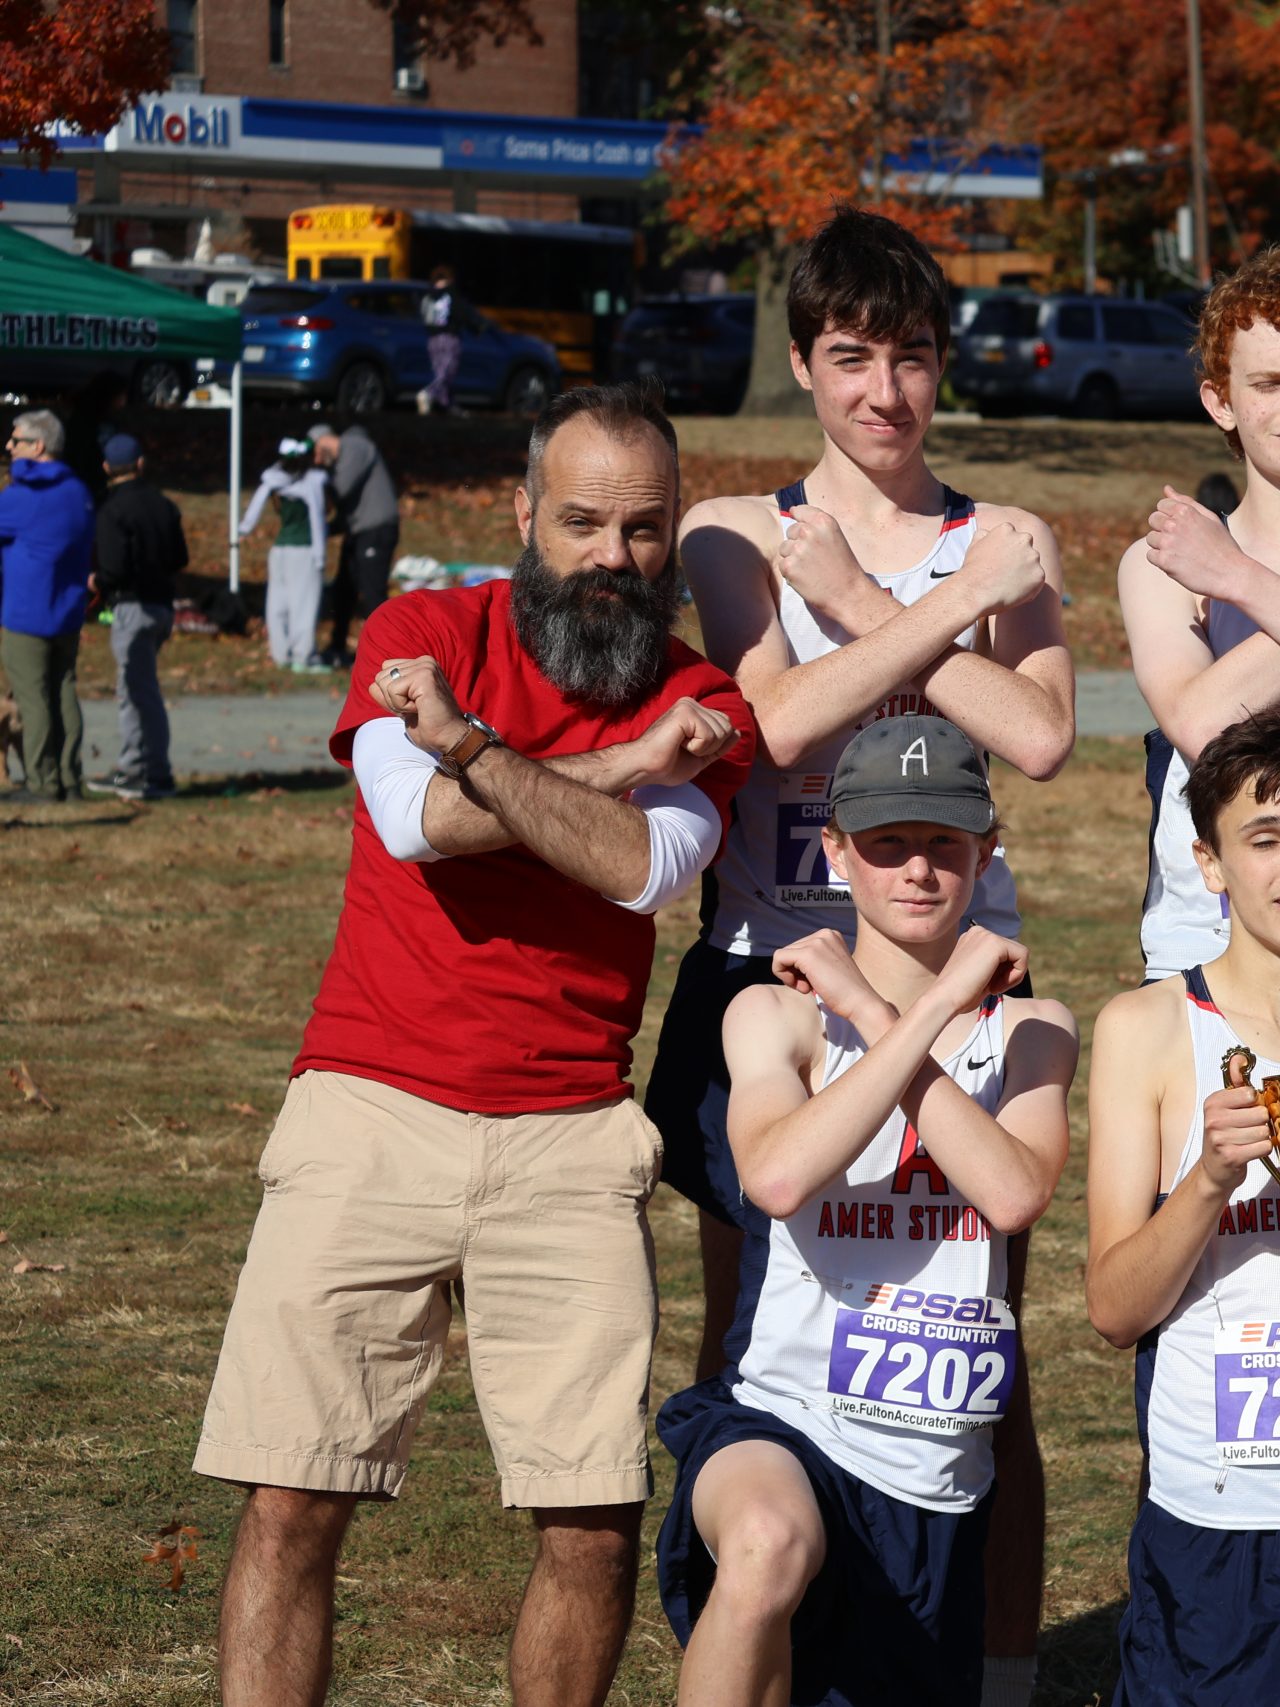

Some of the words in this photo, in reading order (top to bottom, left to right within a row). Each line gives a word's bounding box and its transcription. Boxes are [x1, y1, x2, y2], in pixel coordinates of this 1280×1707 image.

[133, 103, 230, 146] Mobil
[552, 140, 590, 163] Price
[594, 143, 630, 165] Cash
[0, 312, 158, 350] THLETICS
[900, 736, 928, 776] A
[818, 1202, 894, 1239] AMER
[862, 1314, 920, 1336] CROSS
[924, 1320, 999, 1344] COUNTRY
[846, 1334, 1006, 1412] 7202
[833, 1398, 991, 1432] Live.FultonAccurateTiming.co
